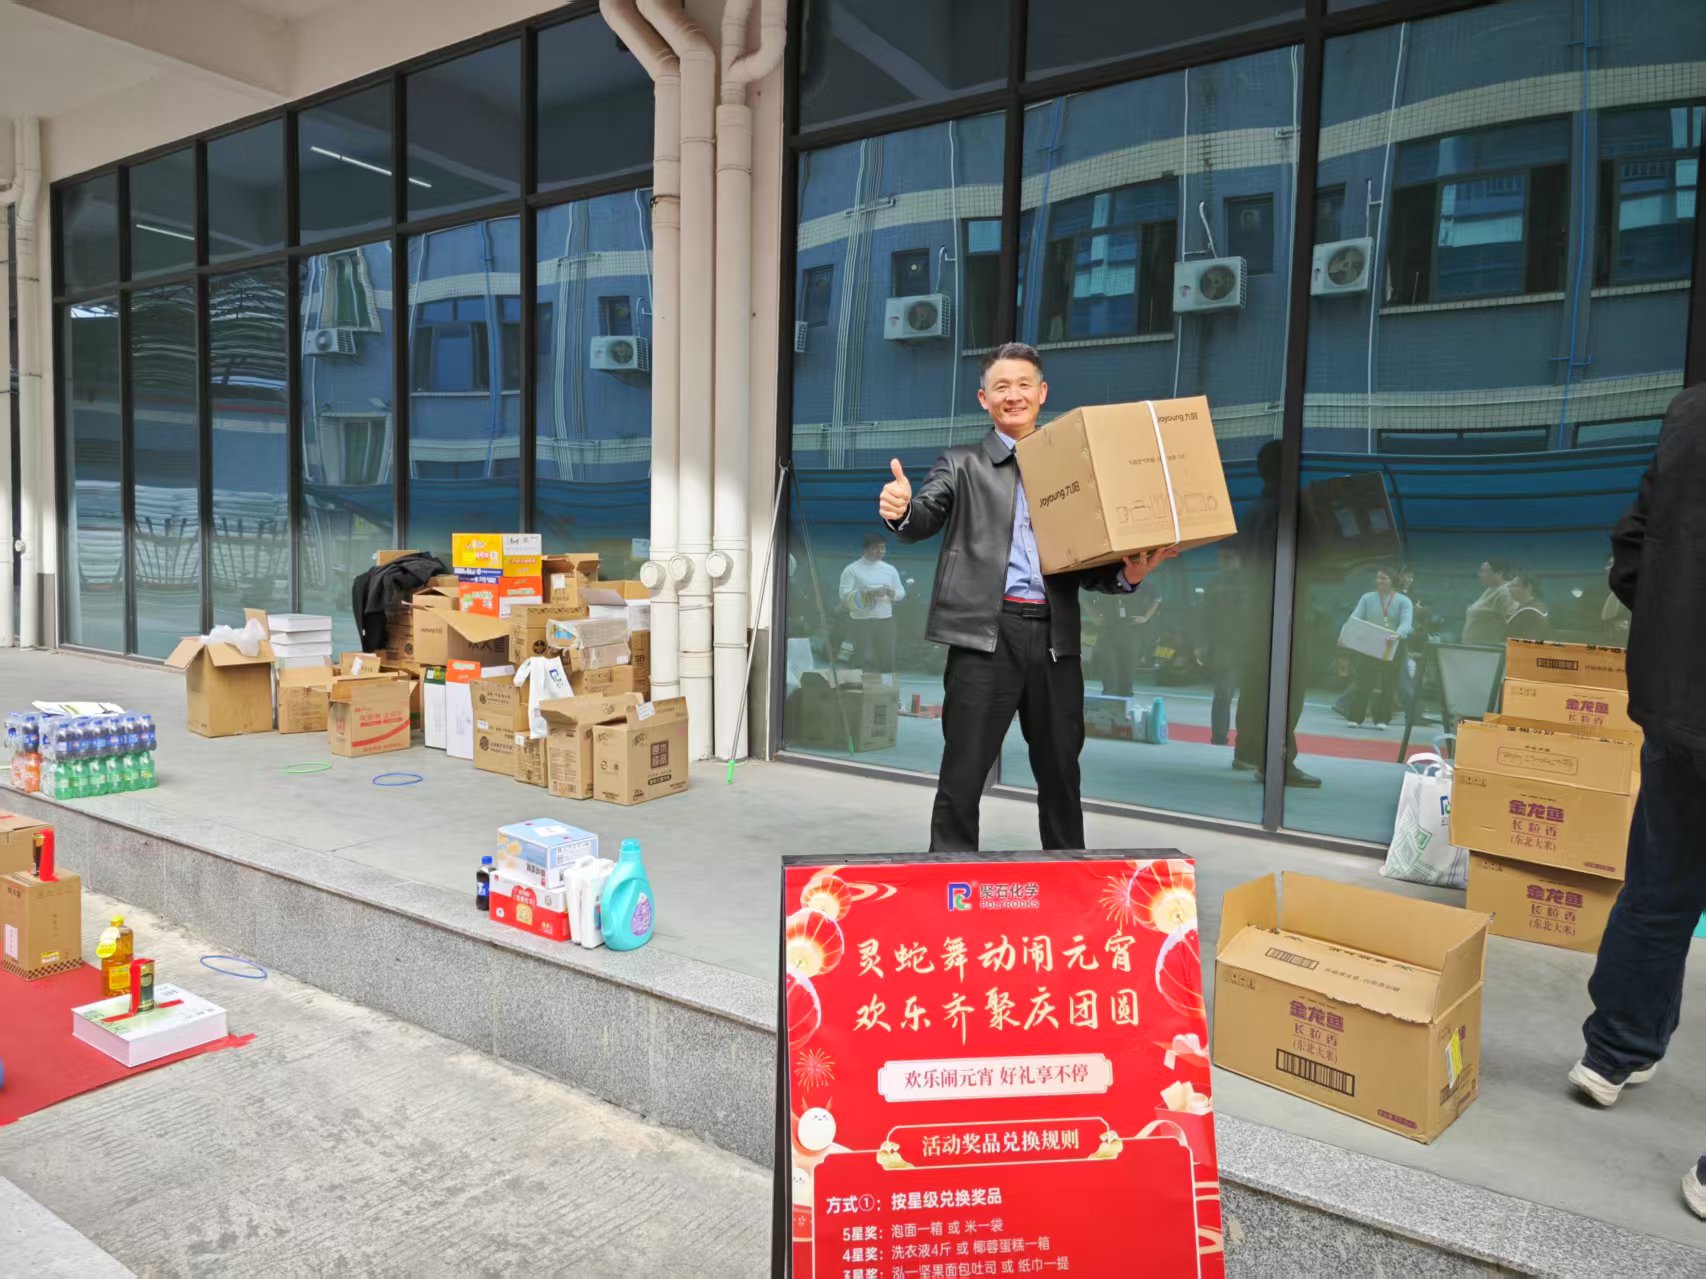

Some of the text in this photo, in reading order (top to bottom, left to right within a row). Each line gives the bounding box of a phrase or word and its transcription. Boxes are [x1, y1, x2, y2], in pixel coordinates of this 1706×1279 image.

[1565, 698, 1609, 715] 金龙鱼
[1568, 713, 1604, 725] 长粒香
[1509, 799, 1565, 823] 金龙鱼
[1512, 819, 1557, 837] 长粒香
[980, 883, 1038, 899] 聚石化学
[1527, 884, 1584, 908] 金龙鱼
[980, 900, 1039, 909] POLYROCKS
[1531, 903, 1576, 922] 长粒香
[857, 930, 1137, 983] 灵蛇舞动闹元宵
[853, 986, 1139, 1046] 欢乐齐聚庆团圆
[1289, 999, 1345, 1033] 金龙鱼
[1293, 1022, 1338, 1047] 长粒香
[904, 1063, 1089, 1089] 欢乐闹元宵 好礼享不停
[922, 1128, 1080, 1157] 活动奖品兑换规则
[891, 1187, 1002, 1211] 按星级兑换奖品
[891, 1221, 942, 1238] 泡面一箱
[948, 1220, 960, 1235] 或
[965, 1218, 1003, 1233] 米一袋
[891, 1241, 951, 1260] 洗衣液4斤
[956, 1240, 969, 1255] 或
[973, 1236, 1050, 1255] 椰蓉蛋糕一箱
[1001, 1259, 1014, 1274] 或
[1018, 1255, 1069, 1273] 纸巾一提
